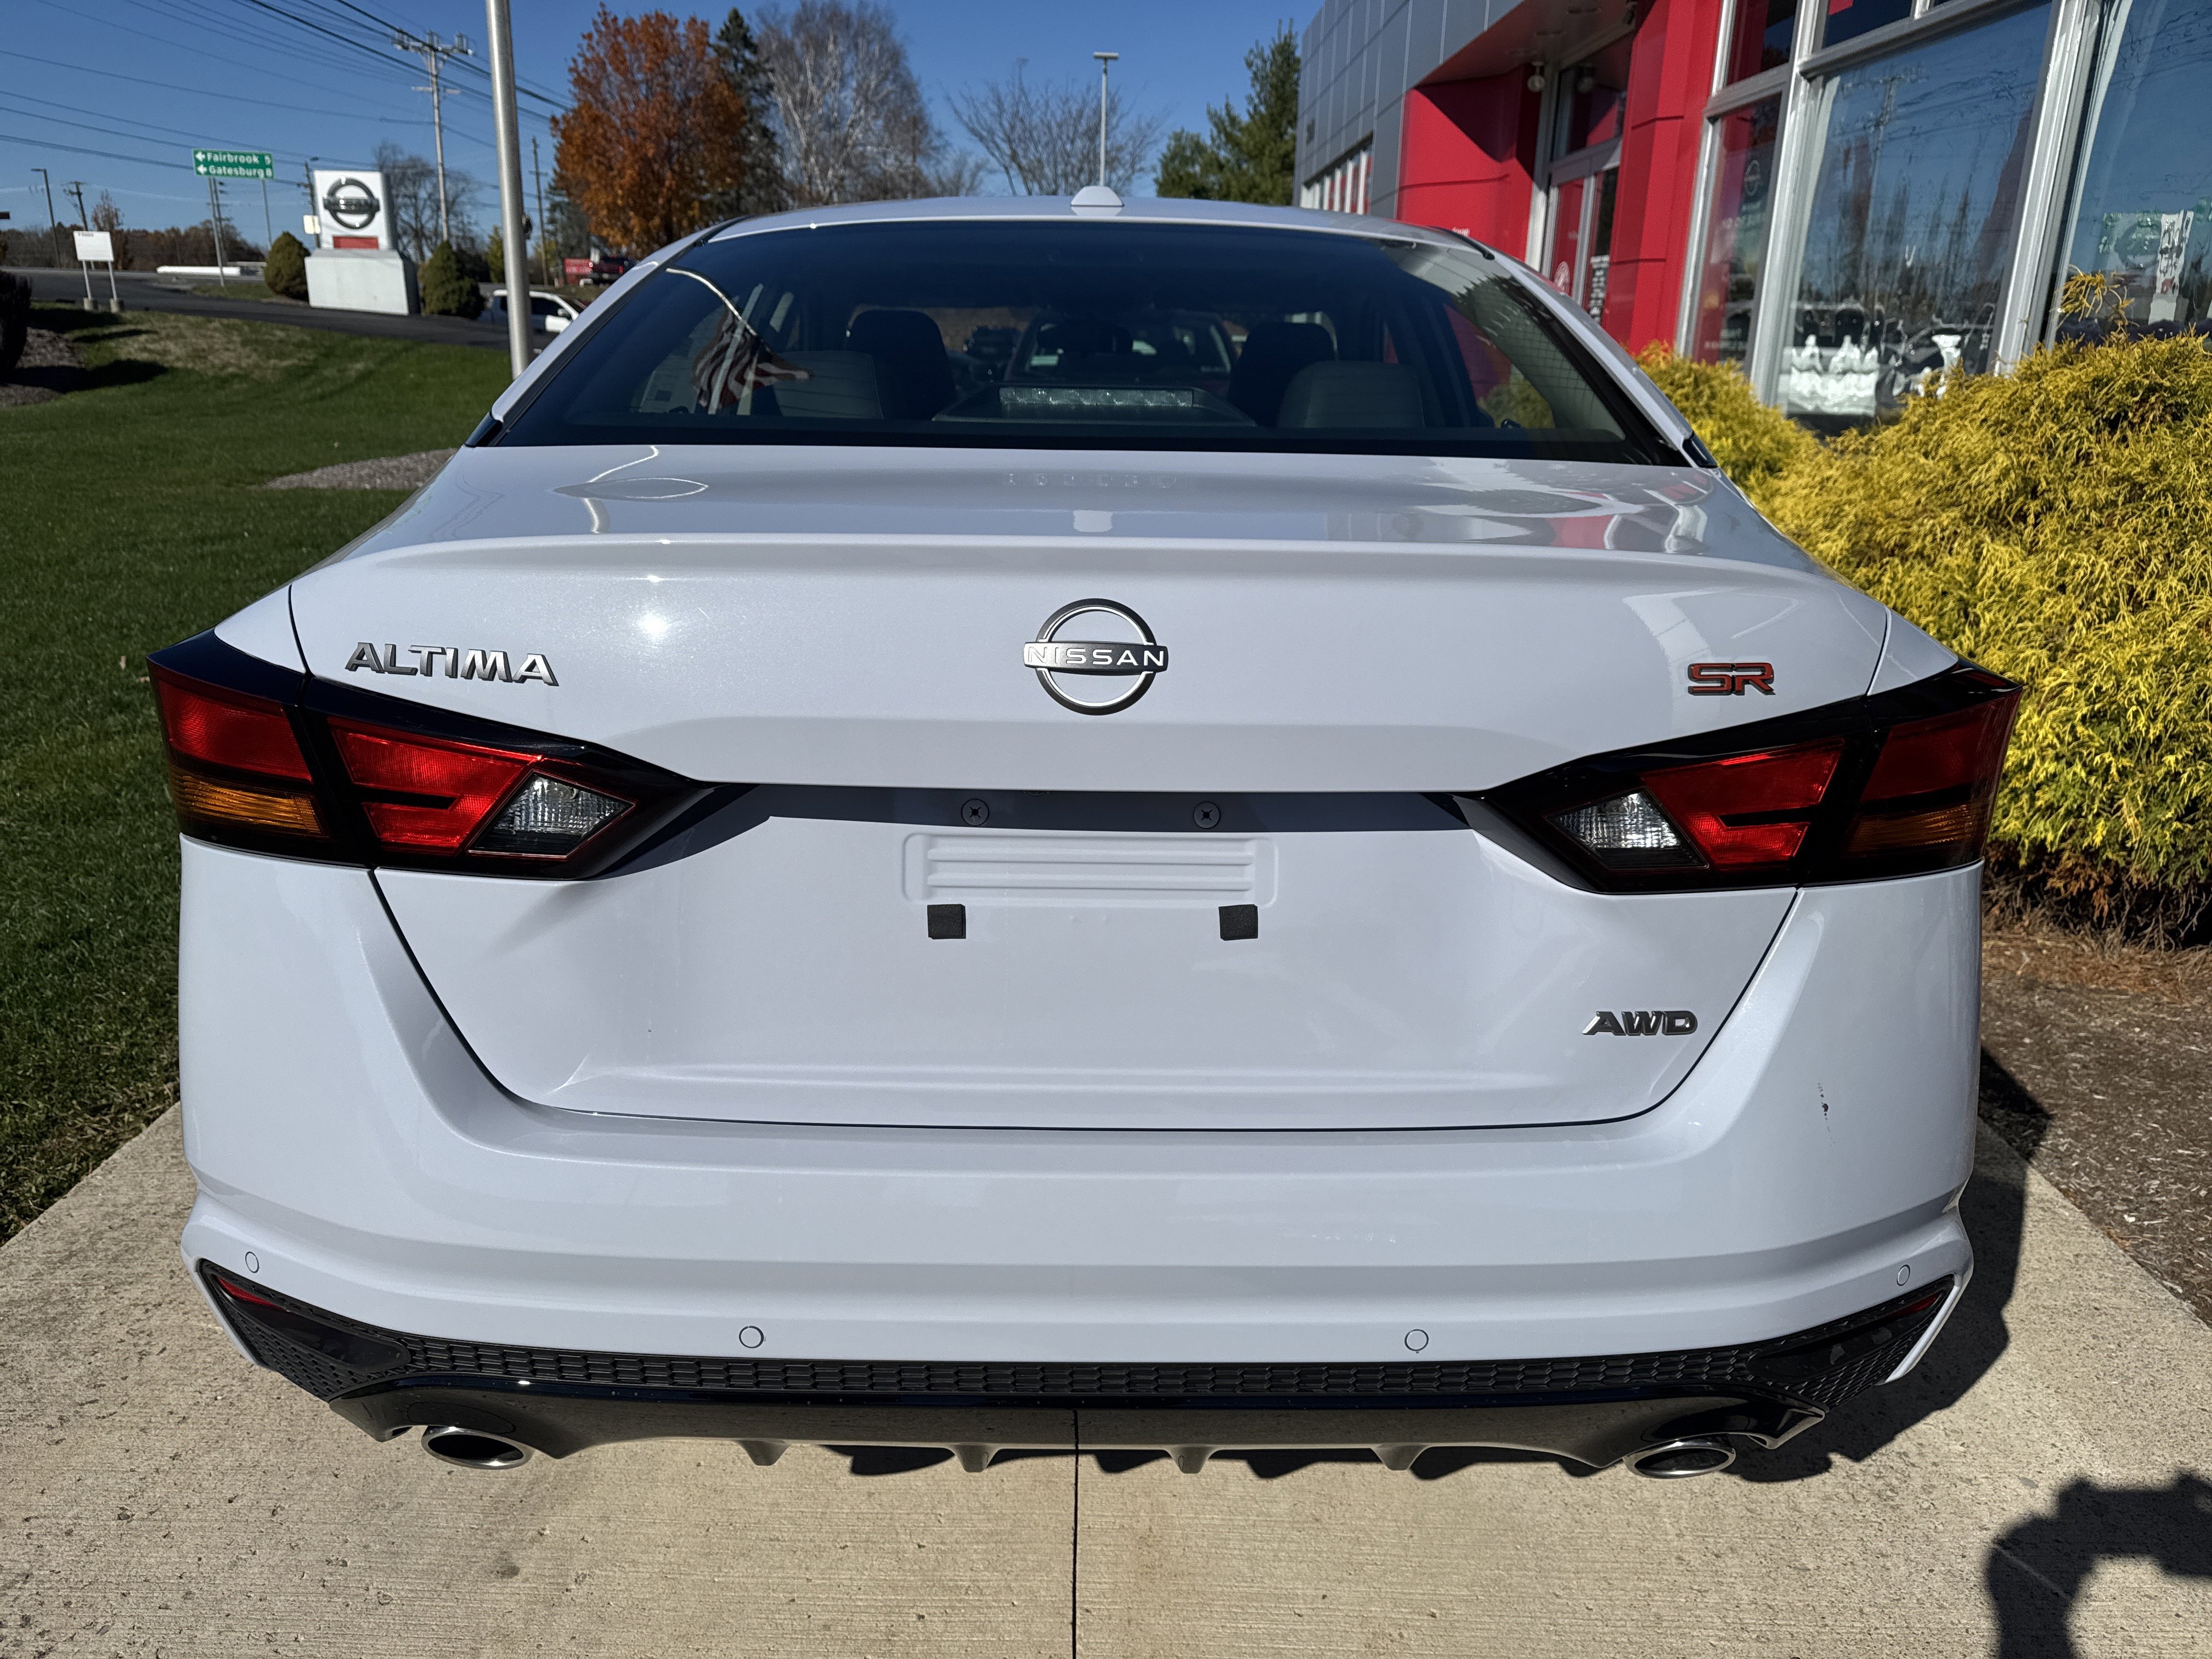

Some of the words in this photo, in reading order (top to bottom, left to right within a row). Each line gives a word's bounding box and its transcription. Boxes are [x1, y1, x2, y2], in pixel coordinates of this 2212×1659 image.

[207, 152, 259, 164] Fairbrook
[208, 165, 264, 179] Gatesburg
[345, 642, 559, 686] ALTIMA
[1028, 646, 1164, 667] NISSAN
[1688, 662, 1776, 696] SR
[1582, 1011, 1698, 1036] AWD
